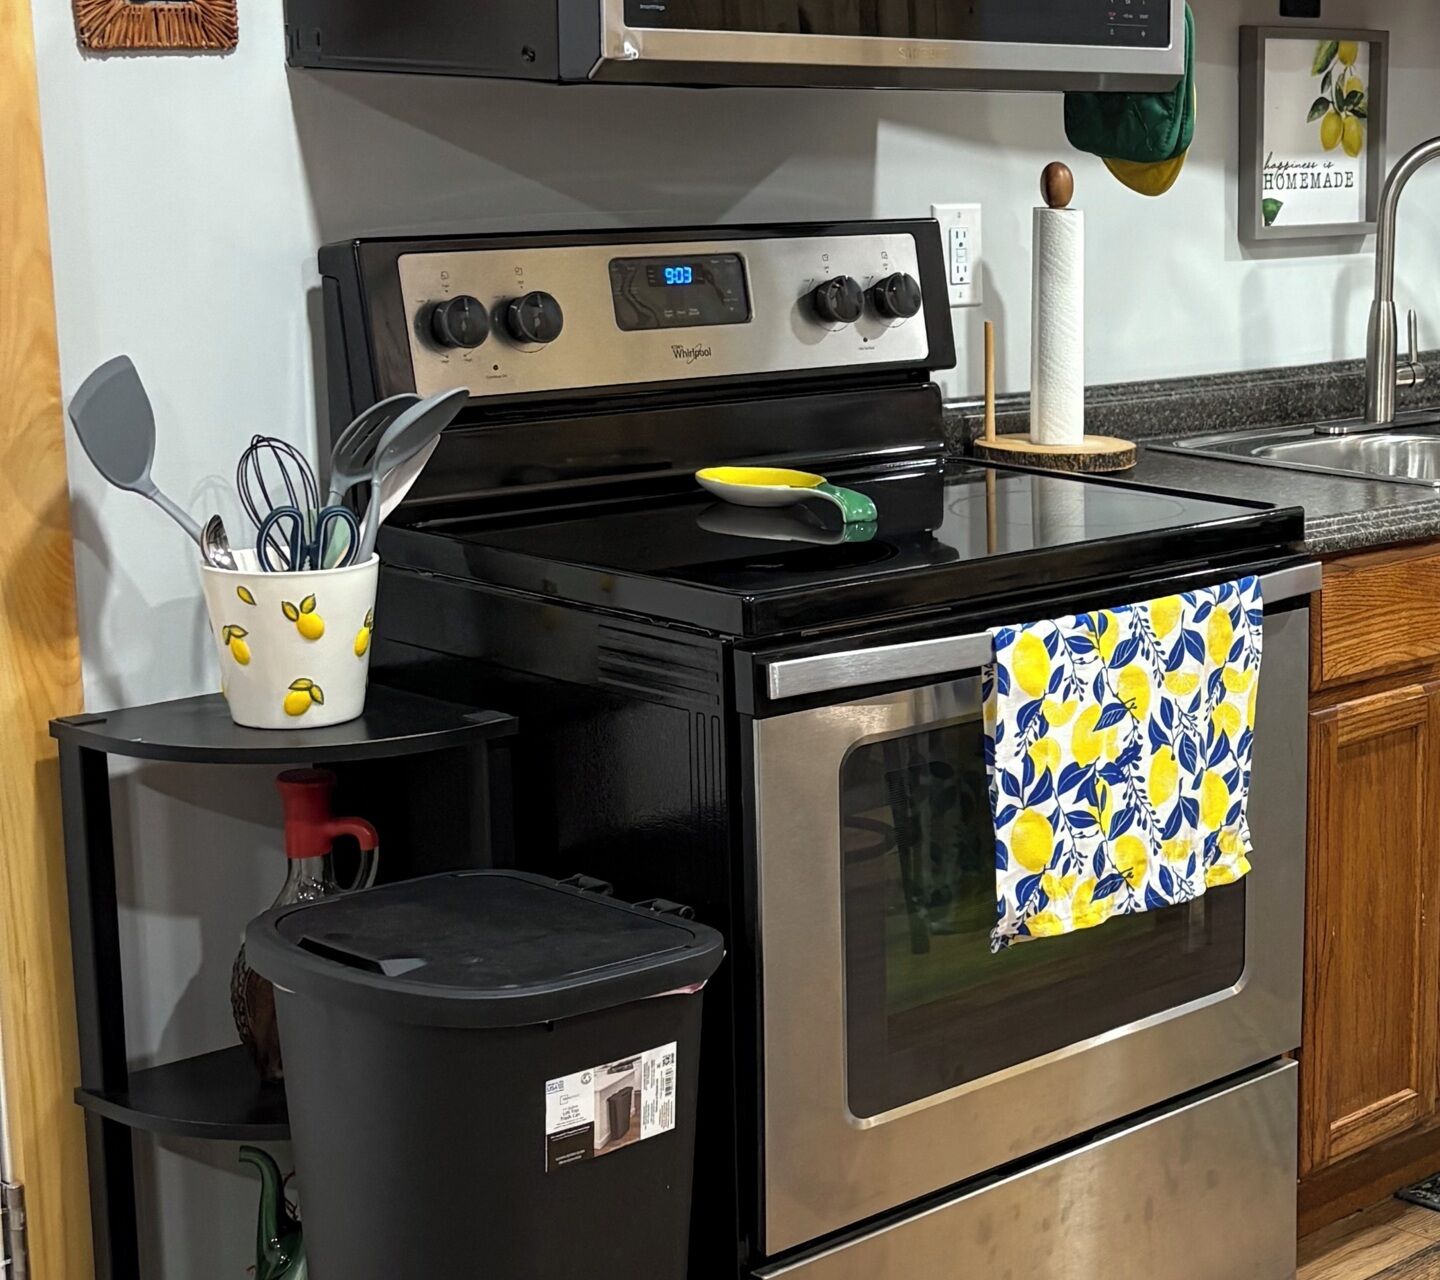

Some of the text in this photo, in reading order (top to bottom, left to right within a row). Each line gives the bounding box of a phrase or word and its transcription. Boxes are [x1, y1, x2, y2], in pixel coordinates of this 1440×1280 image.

[1263, 151, 1334, 180] happiness is
[1263, 171, 1354, 190] HOMEMADE
[664, 266, 692, 285] 9:03
[671, 345, 712, 363] Whirlpool
